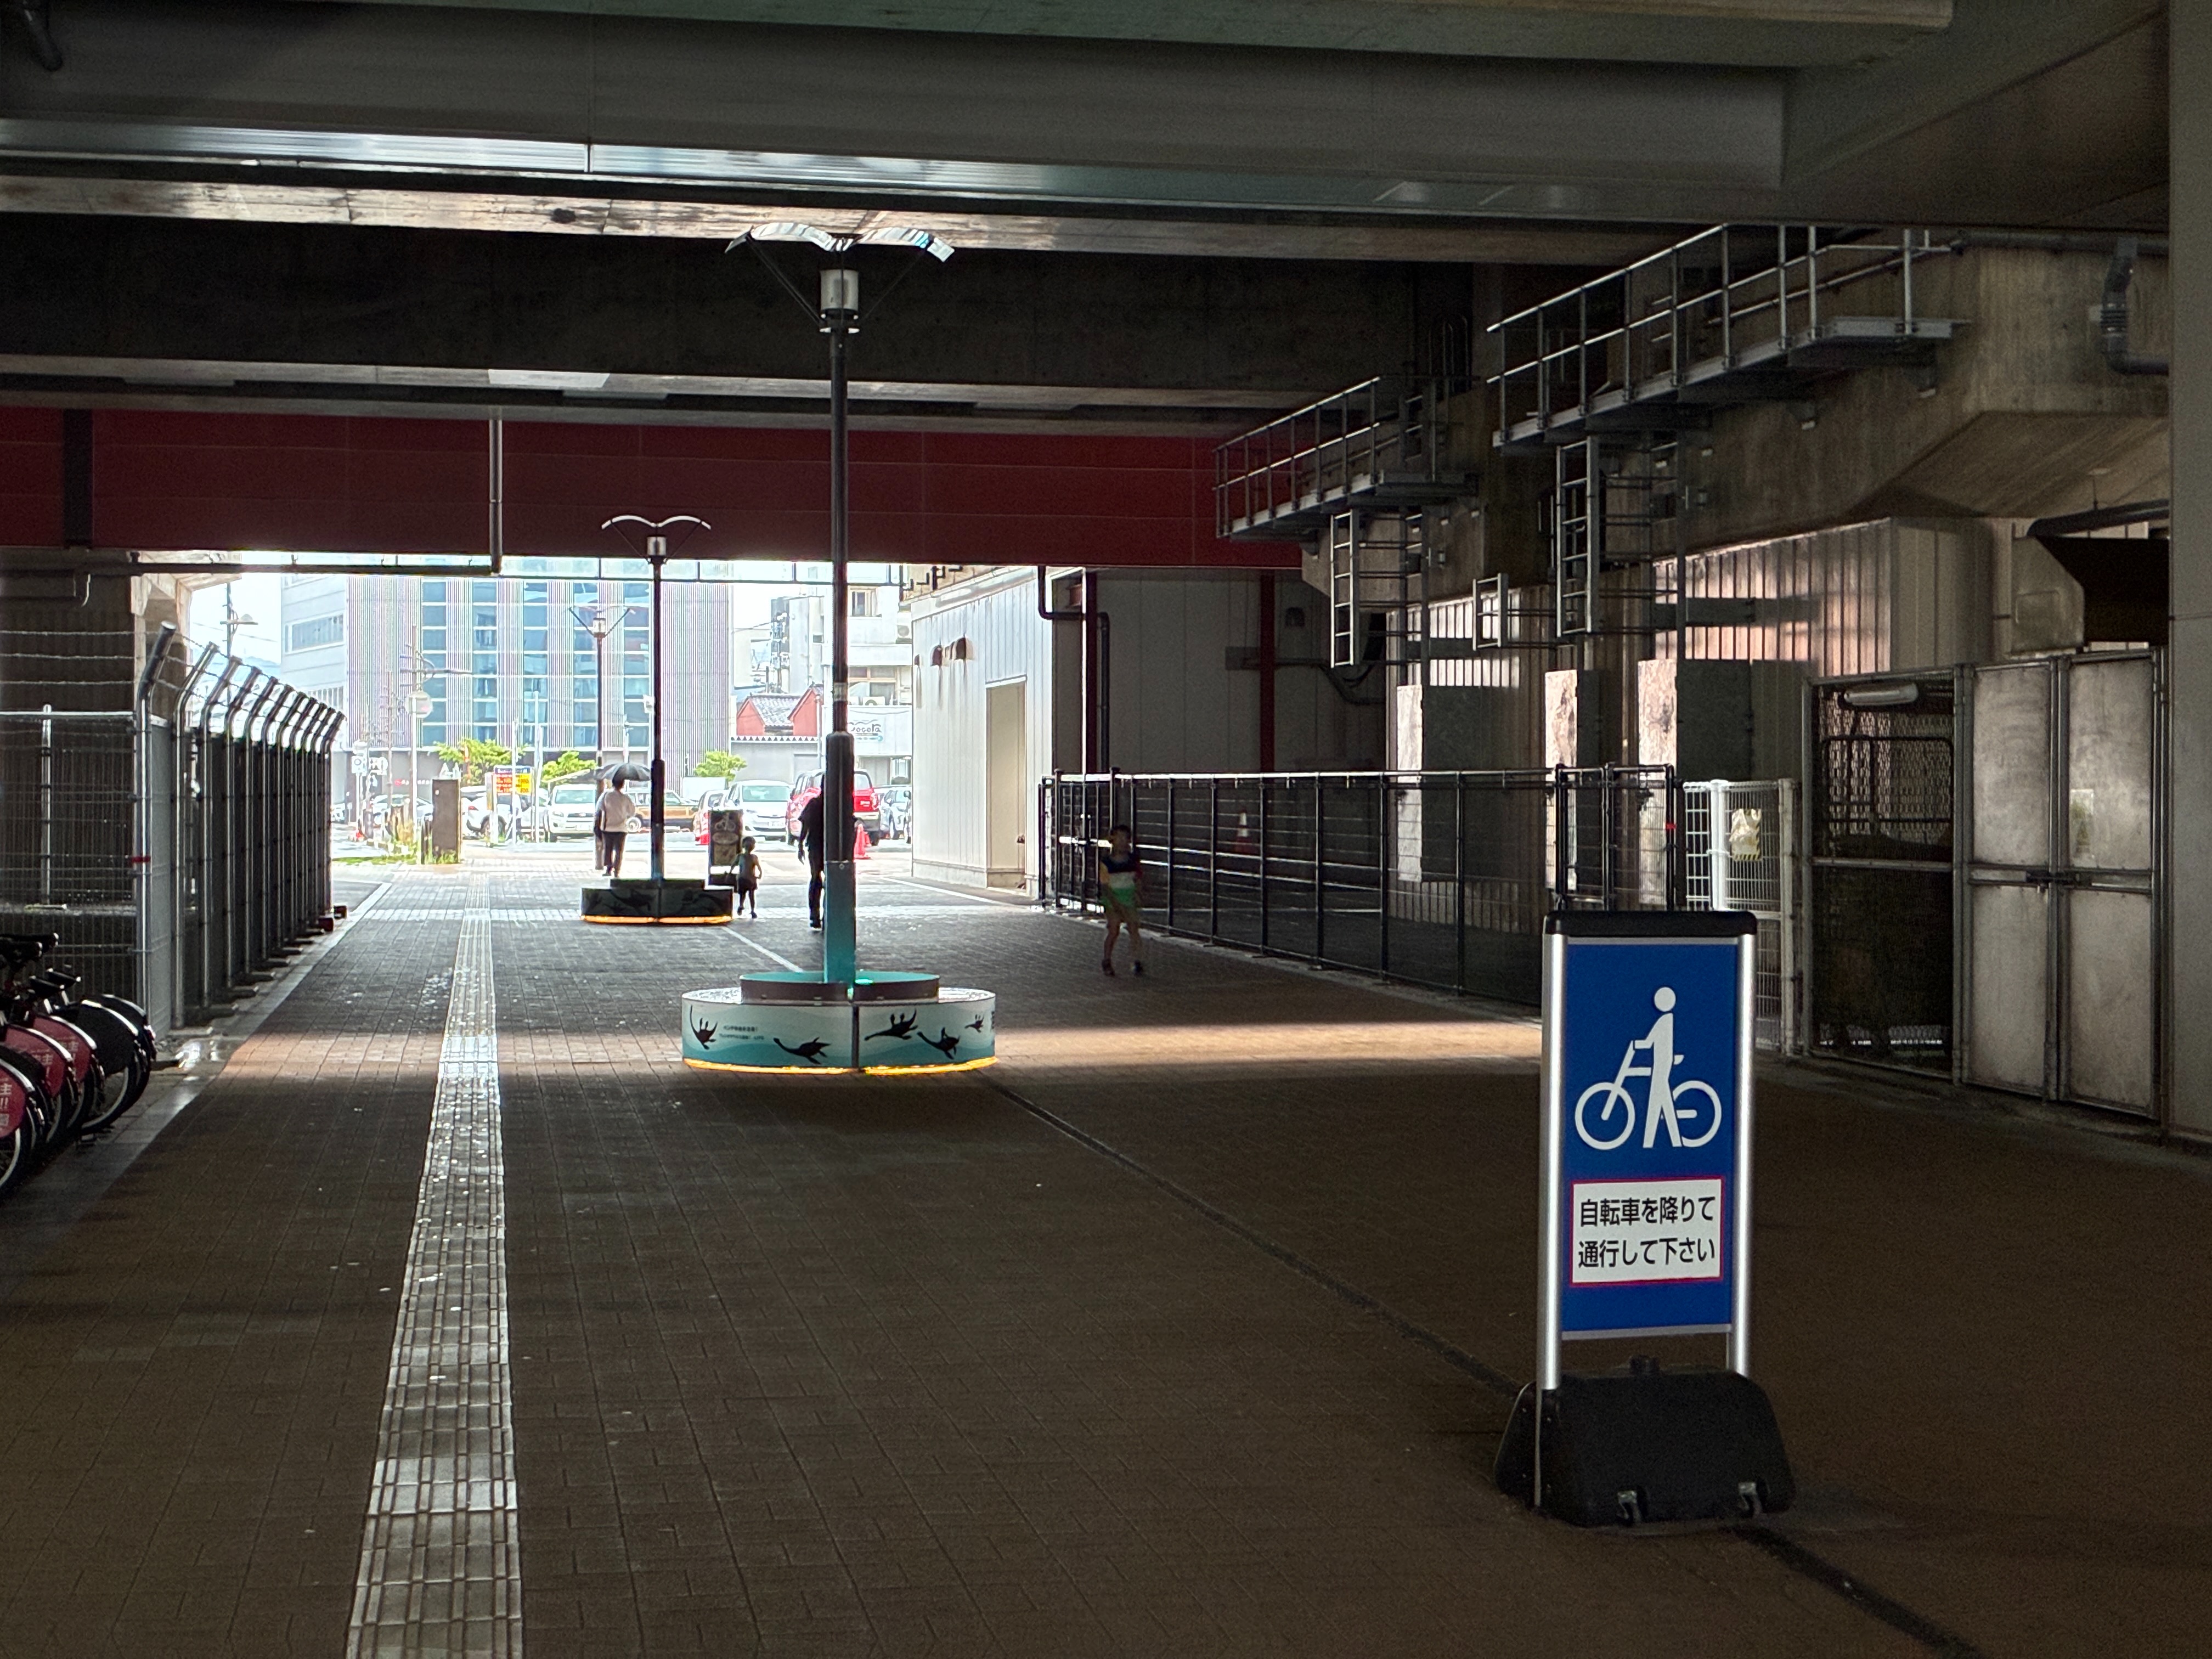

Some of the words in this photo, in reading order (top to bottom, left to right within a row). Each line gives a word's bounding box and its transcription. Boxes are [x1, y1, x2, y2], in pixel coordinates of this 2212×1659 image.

[1580, 1196, 1716, 1227] 自転車を降りて
[1578, 1237, 1716, 1268] 通行して下さい
